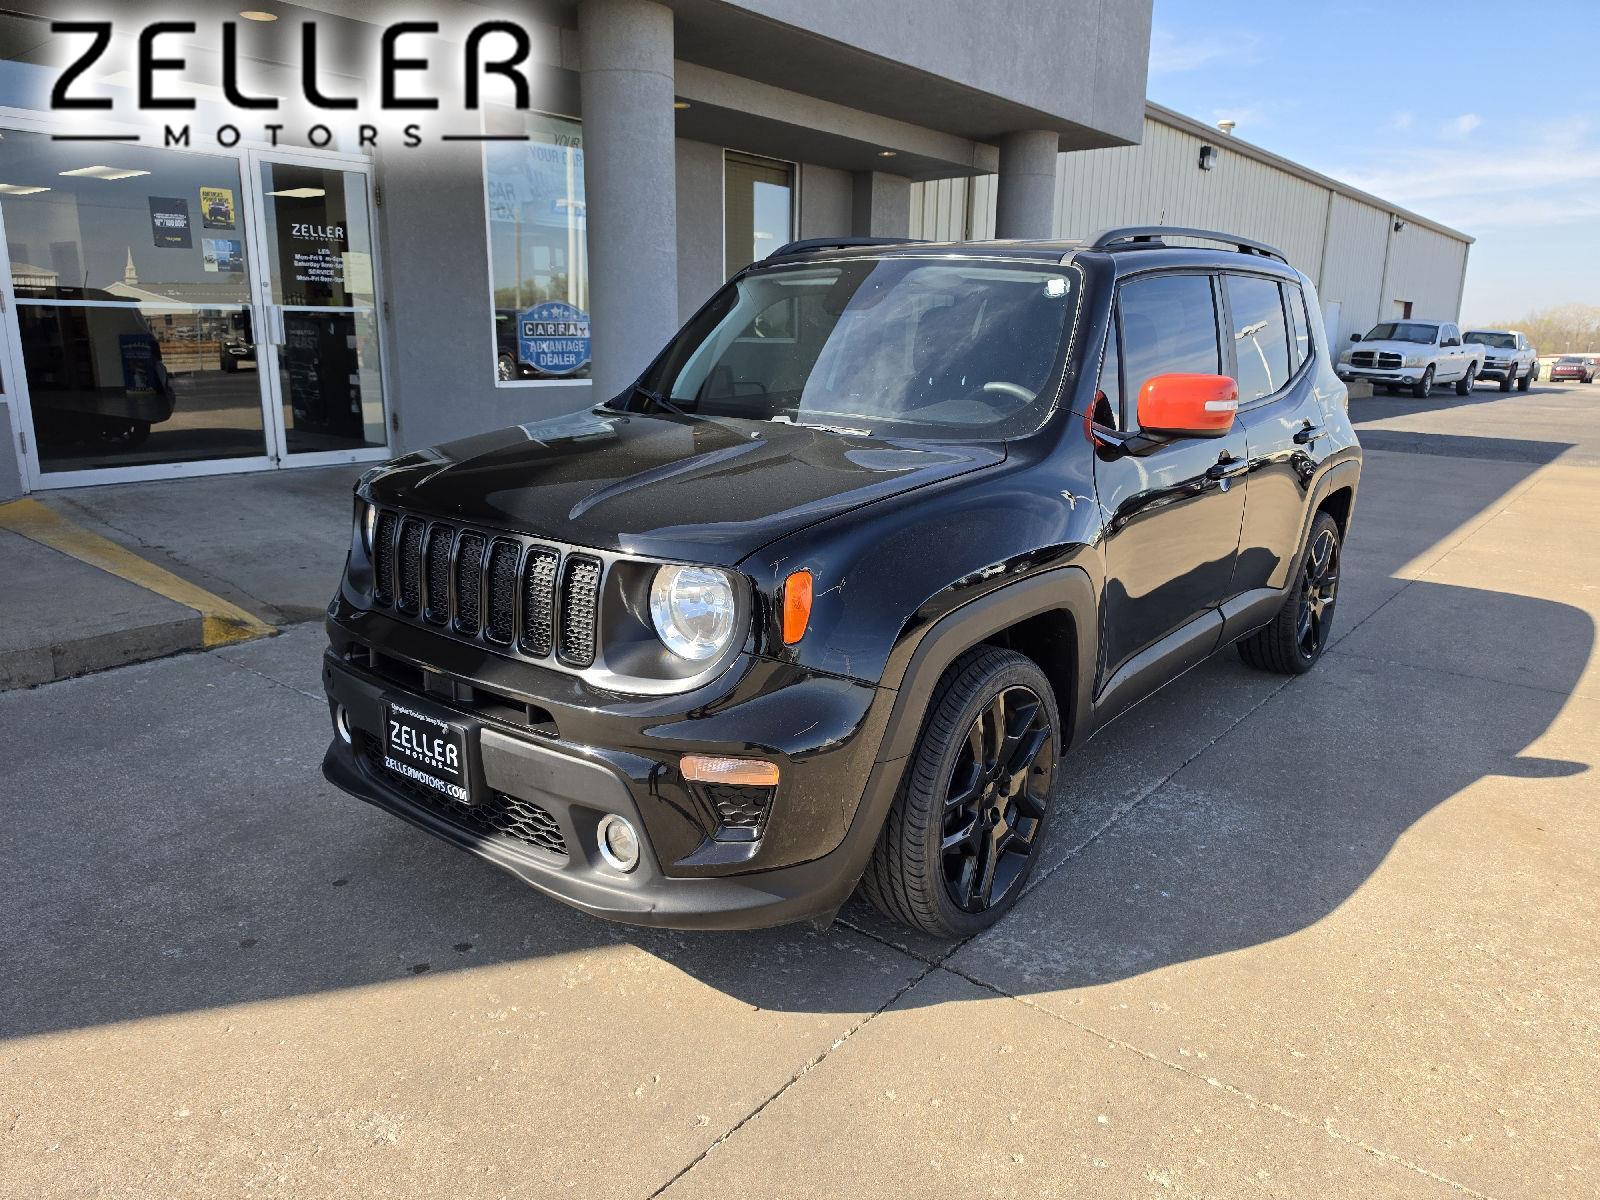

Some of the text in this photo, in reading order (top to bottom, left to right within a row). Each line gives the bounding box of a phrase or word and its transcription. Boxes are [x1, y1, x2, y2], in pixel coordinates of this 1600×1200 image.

[291, 223, 344, 238] ZELLER
[525, 323, 586, 336] CARFAX
[529, 340, 585, 353] ADVANTAGE
[540, 353, 577, 366] DEALER
[389, 720, 458, 768] ZELLER
[405, 747, 443, 769] MOTORS
[384, 755, 468, 801] ZELLERMOTORS.COM
